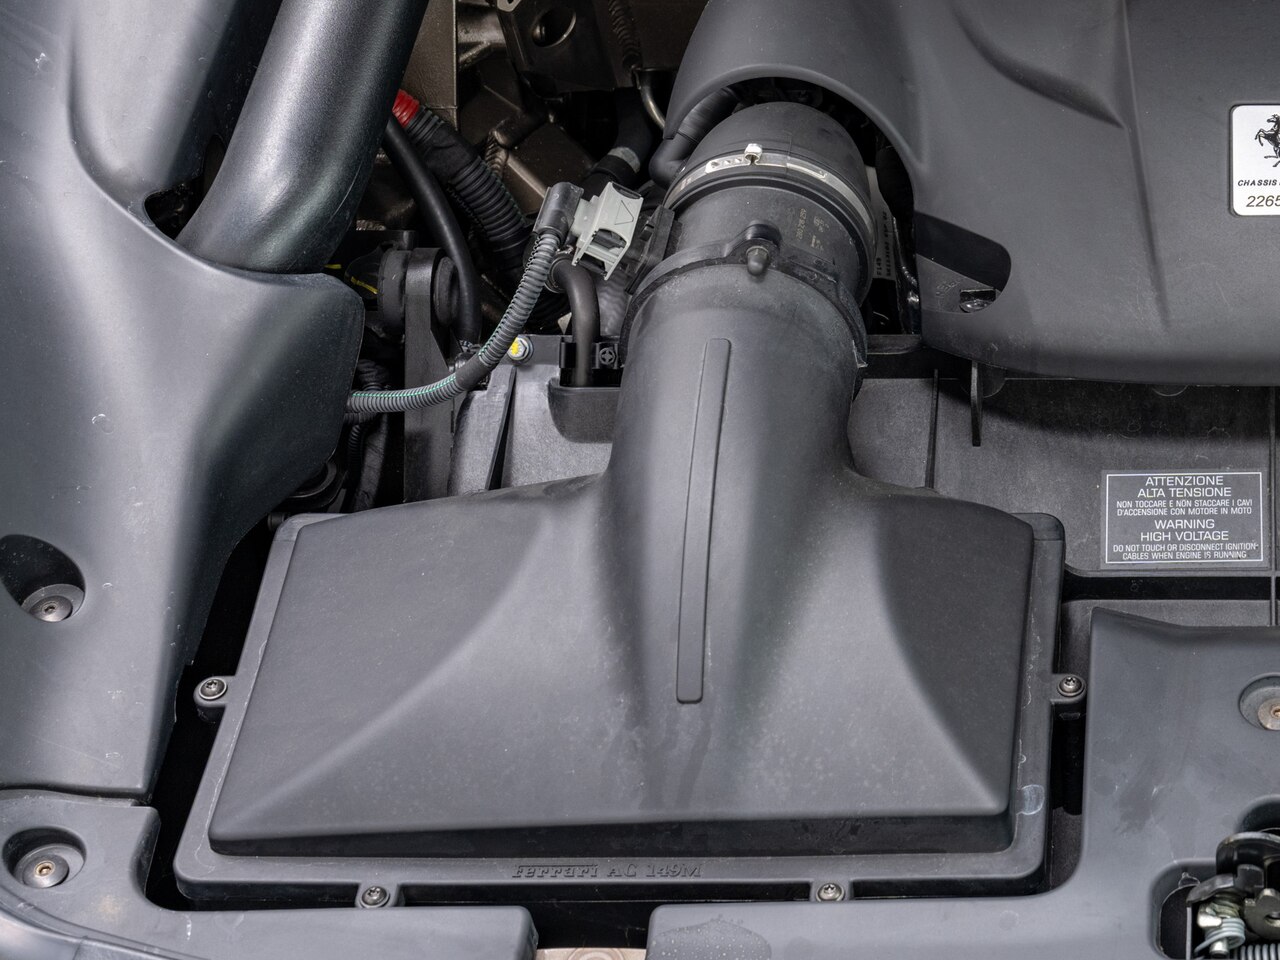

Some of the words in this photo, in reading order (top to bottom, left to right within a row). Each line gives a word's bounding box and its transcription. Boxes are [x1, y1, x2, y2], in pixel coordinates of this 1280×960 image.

[1145, 476, 1224, 486] ATTENZIONE
[1137, 488, 1165, 497] ALTA
[1169, 487, 1232, 497] TENSIONE
[1194, 499, 1229, 507] STACCARE
[1117, 508, 1168, 516] D'ACCENSIONE
[1221, 507, 1228, 515] IN
[1154, 519, 1215, 529] WARNING
[1141, 532, 1171, 542] HIGH
[1175, 531, 1229, 541] VOLTAGE
[1179, 543, 1223, 551] DISCONNECT
[1225, 542, 1256, 550] IGNITION
[1151, 552, 1173, 560] WHEN
[1204, 551, 1211, 559] IS
[512, 864, 598, 878] Ferrari
[607, 864, 637, 878] AC
[645, 864, 701, 878] 149M
